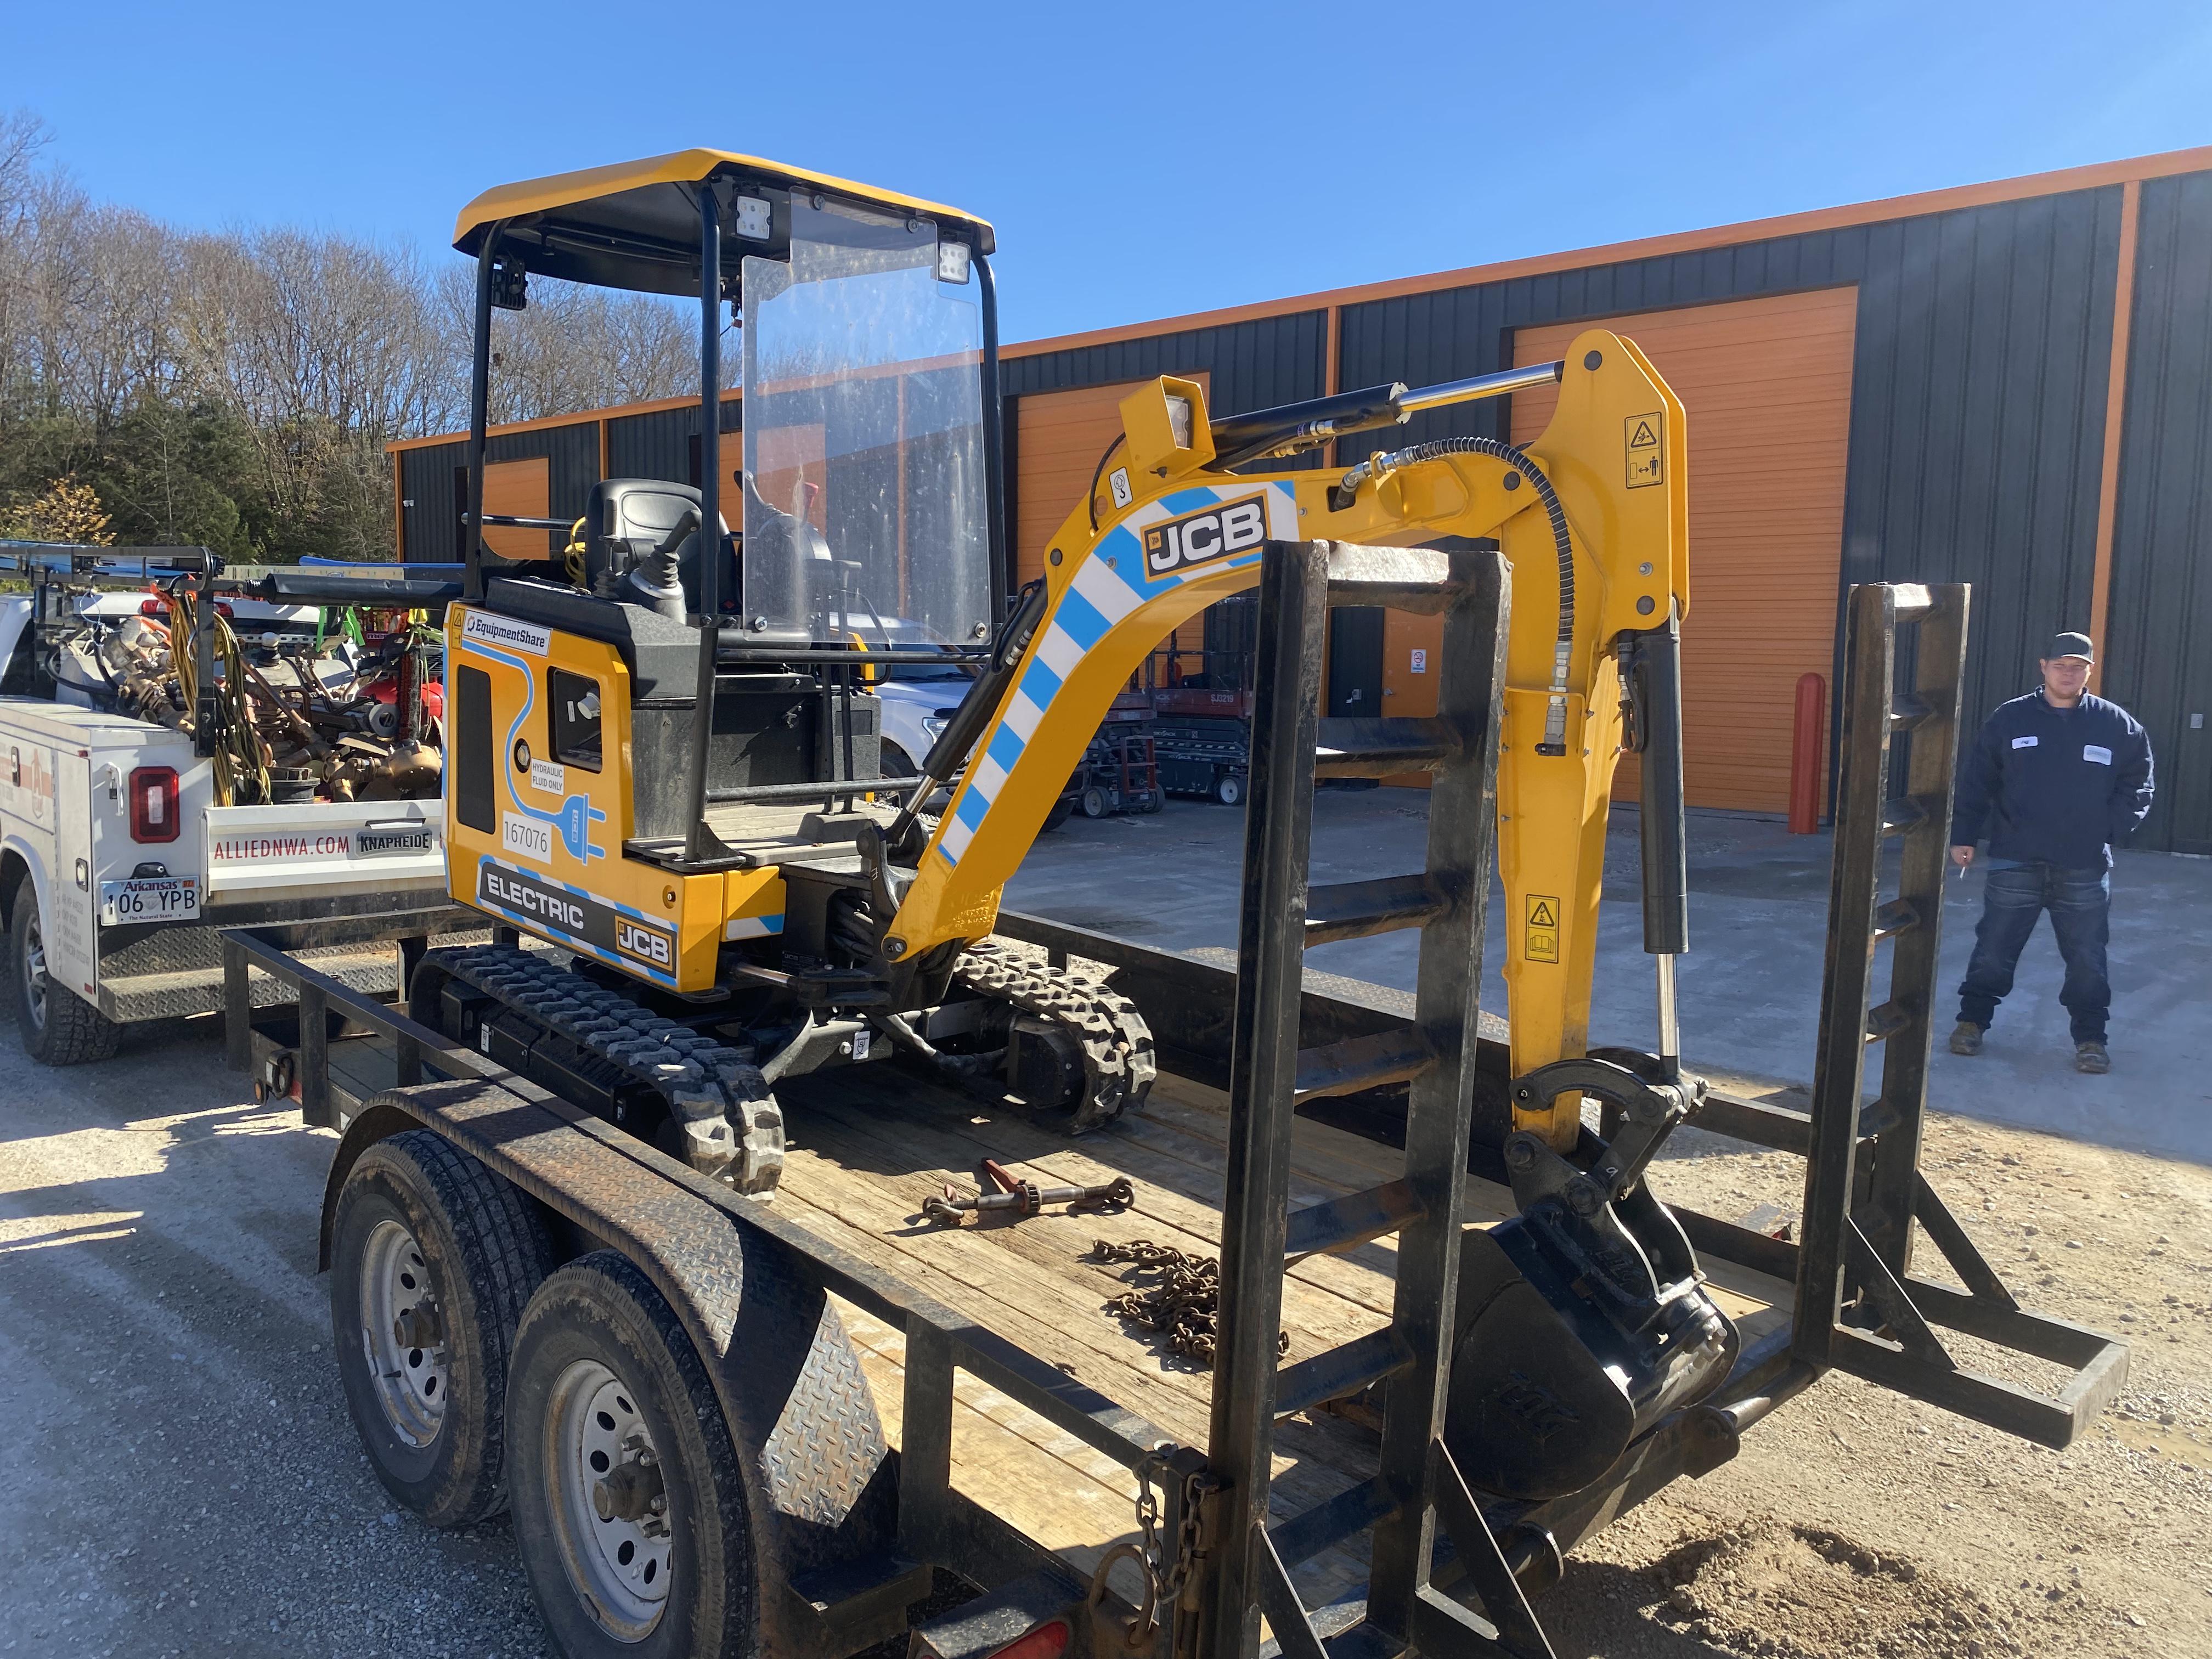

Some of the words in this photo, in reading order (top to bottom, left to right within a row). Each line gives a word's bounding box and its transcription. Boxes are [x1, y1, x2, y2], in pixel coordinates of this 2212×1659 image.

[1150, 503, 1264, 571] JCB
[475, 619, 545, 648] EquipmentShare
[1211, 694, 1234, 703] SJ3219
[532, 763, 563, 778] HYDRAULIC
[532, 776, 548, 787] FLUID
[548, 779, 562, 791] ONLY
[213, 836, 349, 860] ALLIEDNWA.COM
[360, 833, 430, 853] KNAPHEIDE
[504, 821, 548, 853] 167076
[123, 881, 178, 893] Arkansas
[158, 889, 195, 911] YPB
[487, 872, 584, 929] ELECTRIC
[619, 926, 669, 963] JCB
